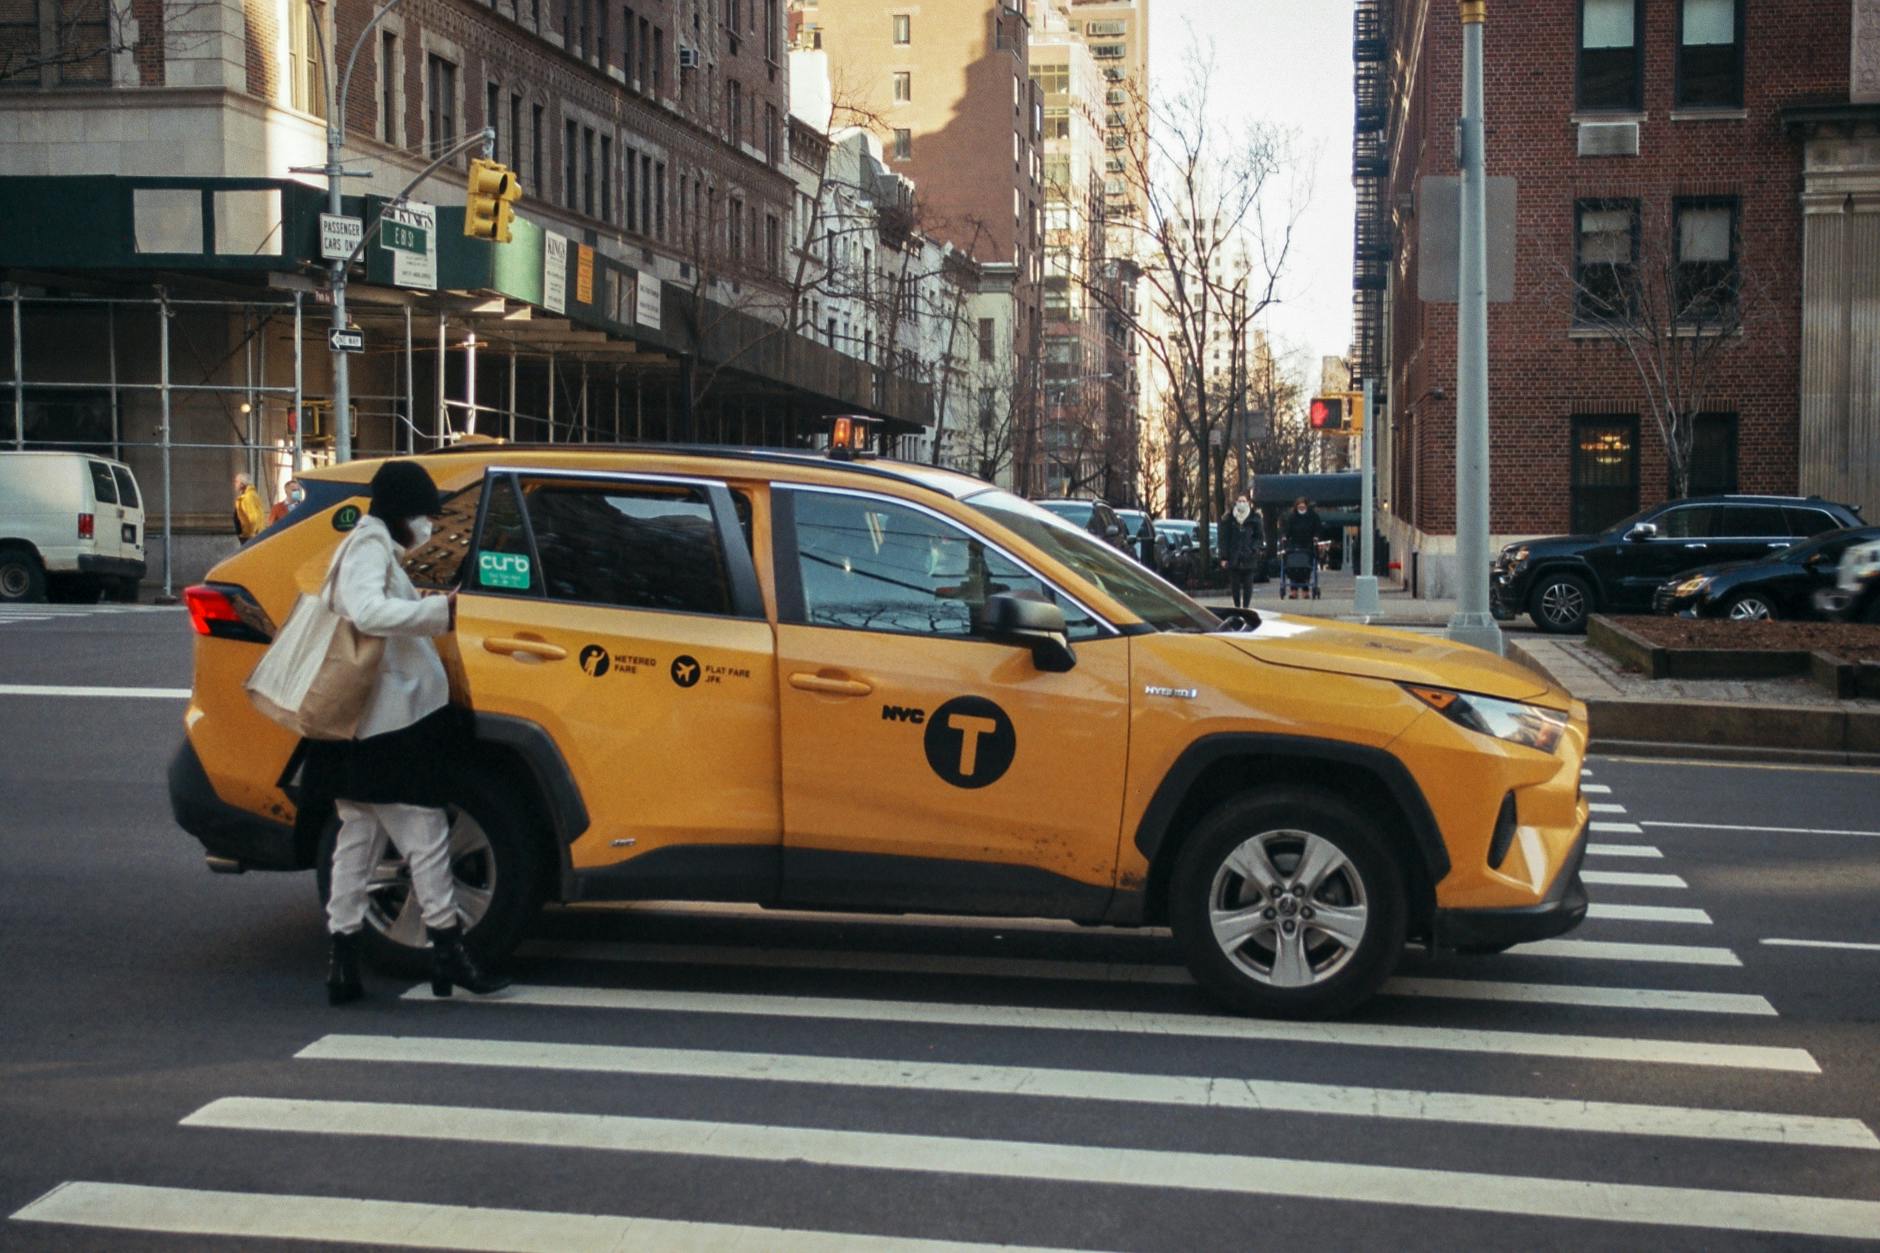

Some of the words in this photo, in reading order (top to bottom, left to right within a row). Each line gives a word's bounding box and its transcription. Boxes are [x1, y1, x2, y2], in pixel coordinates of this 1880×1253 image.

[323, 220, 360, 236] PASSENGER
[395, 227, 400, 245] E
[324, 237, 341, 251] CARS
[336, 335, 346, 345] ONE
[348, 337, 359, 345] WAY
[480, 555, 529, 573] curb
[614, 654, 657, 667] METERED
[614, 664, 637, 675] FARE
[705, 665, 727, 676] FLAT
[728, 667, 751, 678] FARE
[704, 675, 722, 684] JFK
[882, 704, 926, 725] NYC
[947, 713, 997, 777] T
